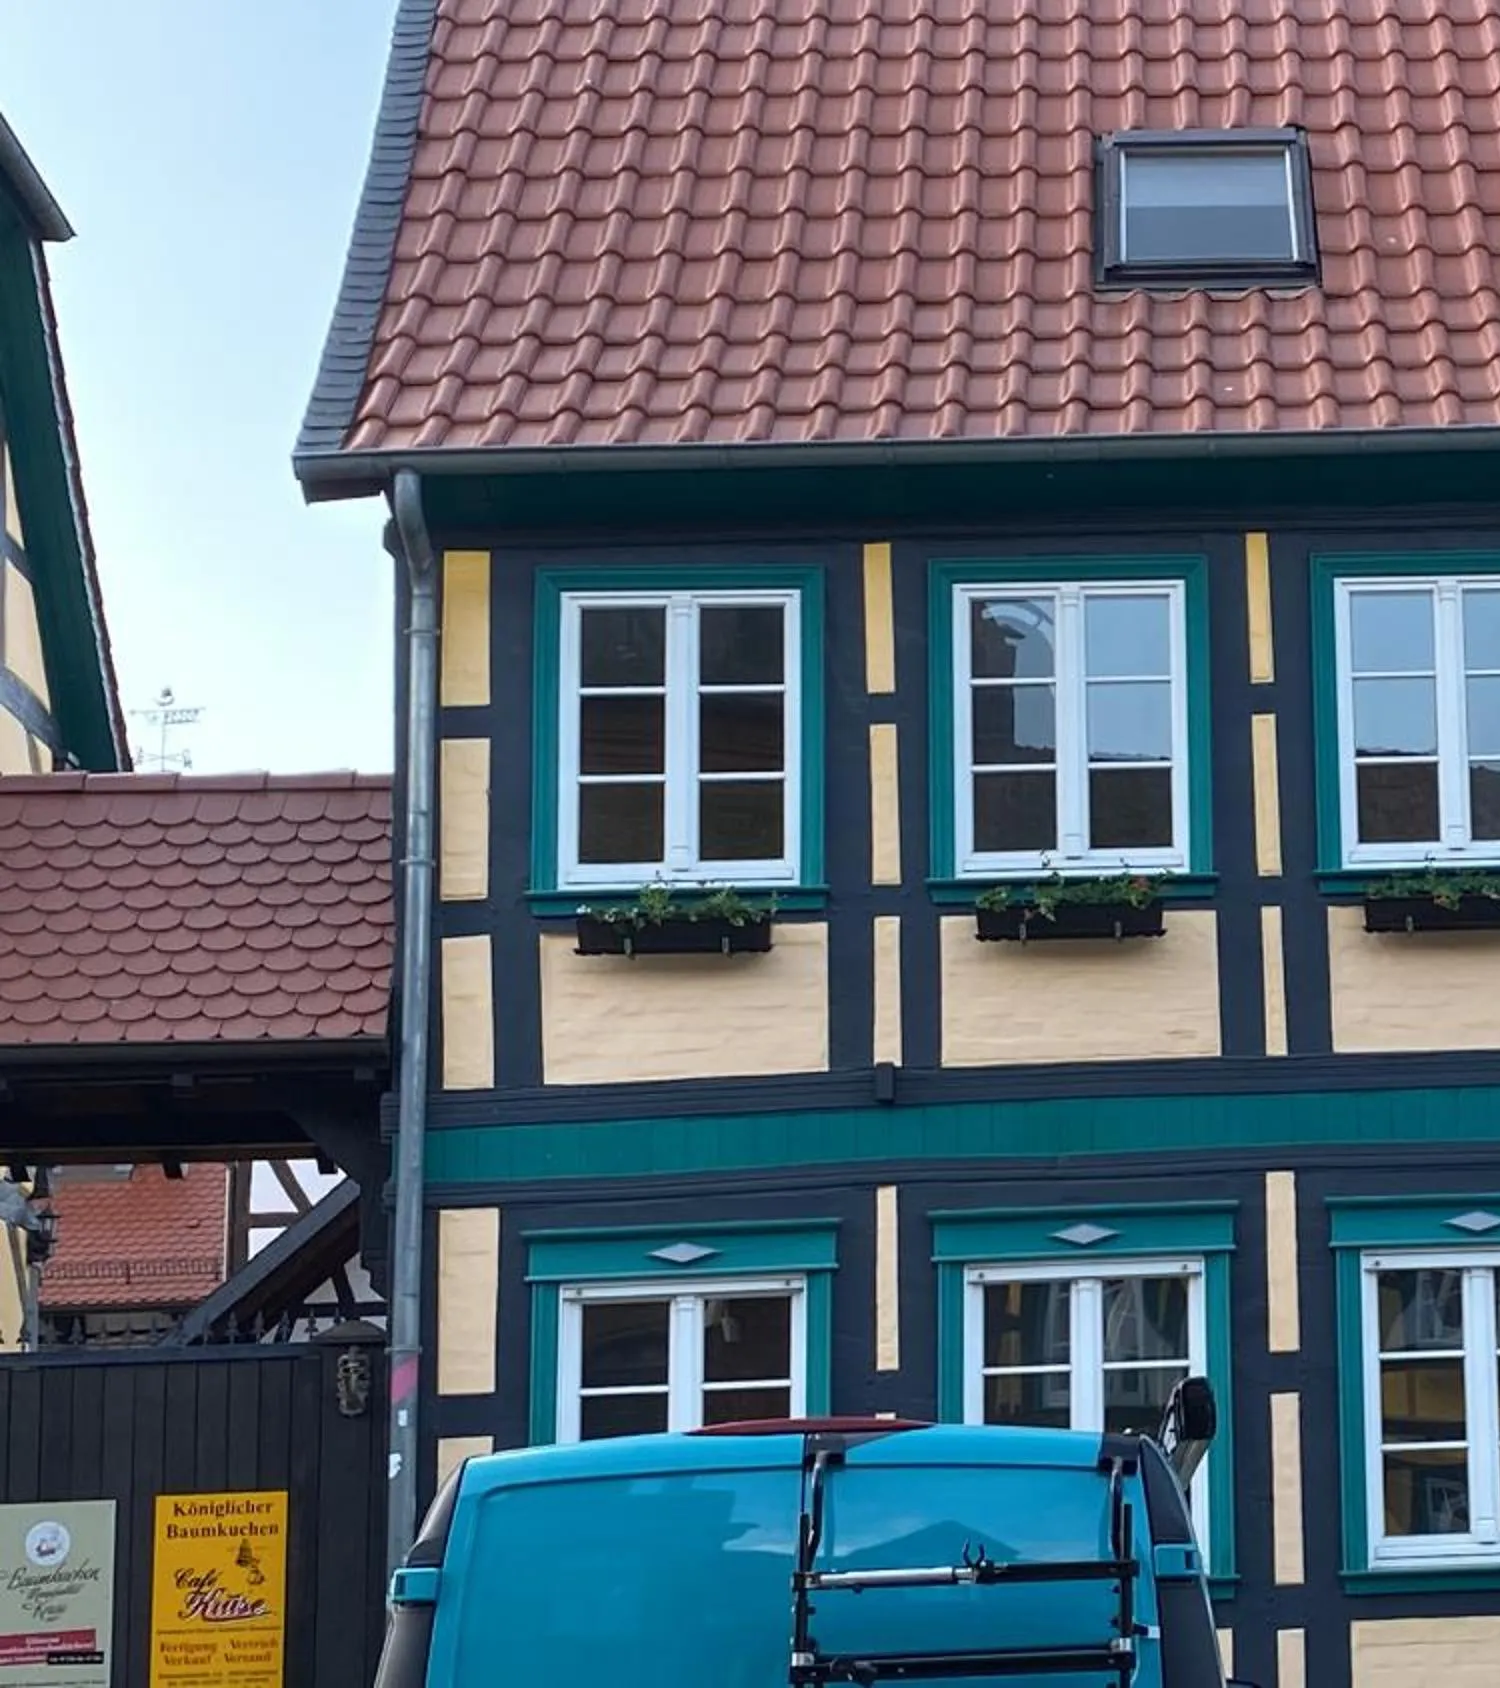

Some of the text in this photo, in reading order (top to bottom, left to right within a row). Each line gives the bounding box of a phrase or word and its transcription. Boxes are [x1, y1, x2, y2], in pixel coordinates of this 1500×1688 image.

[173, 1500, 273, 1518] Königlicher
[166, 1521, 279, 1539] Baumkuchen
[174, 1567, 223, 1590] Café
